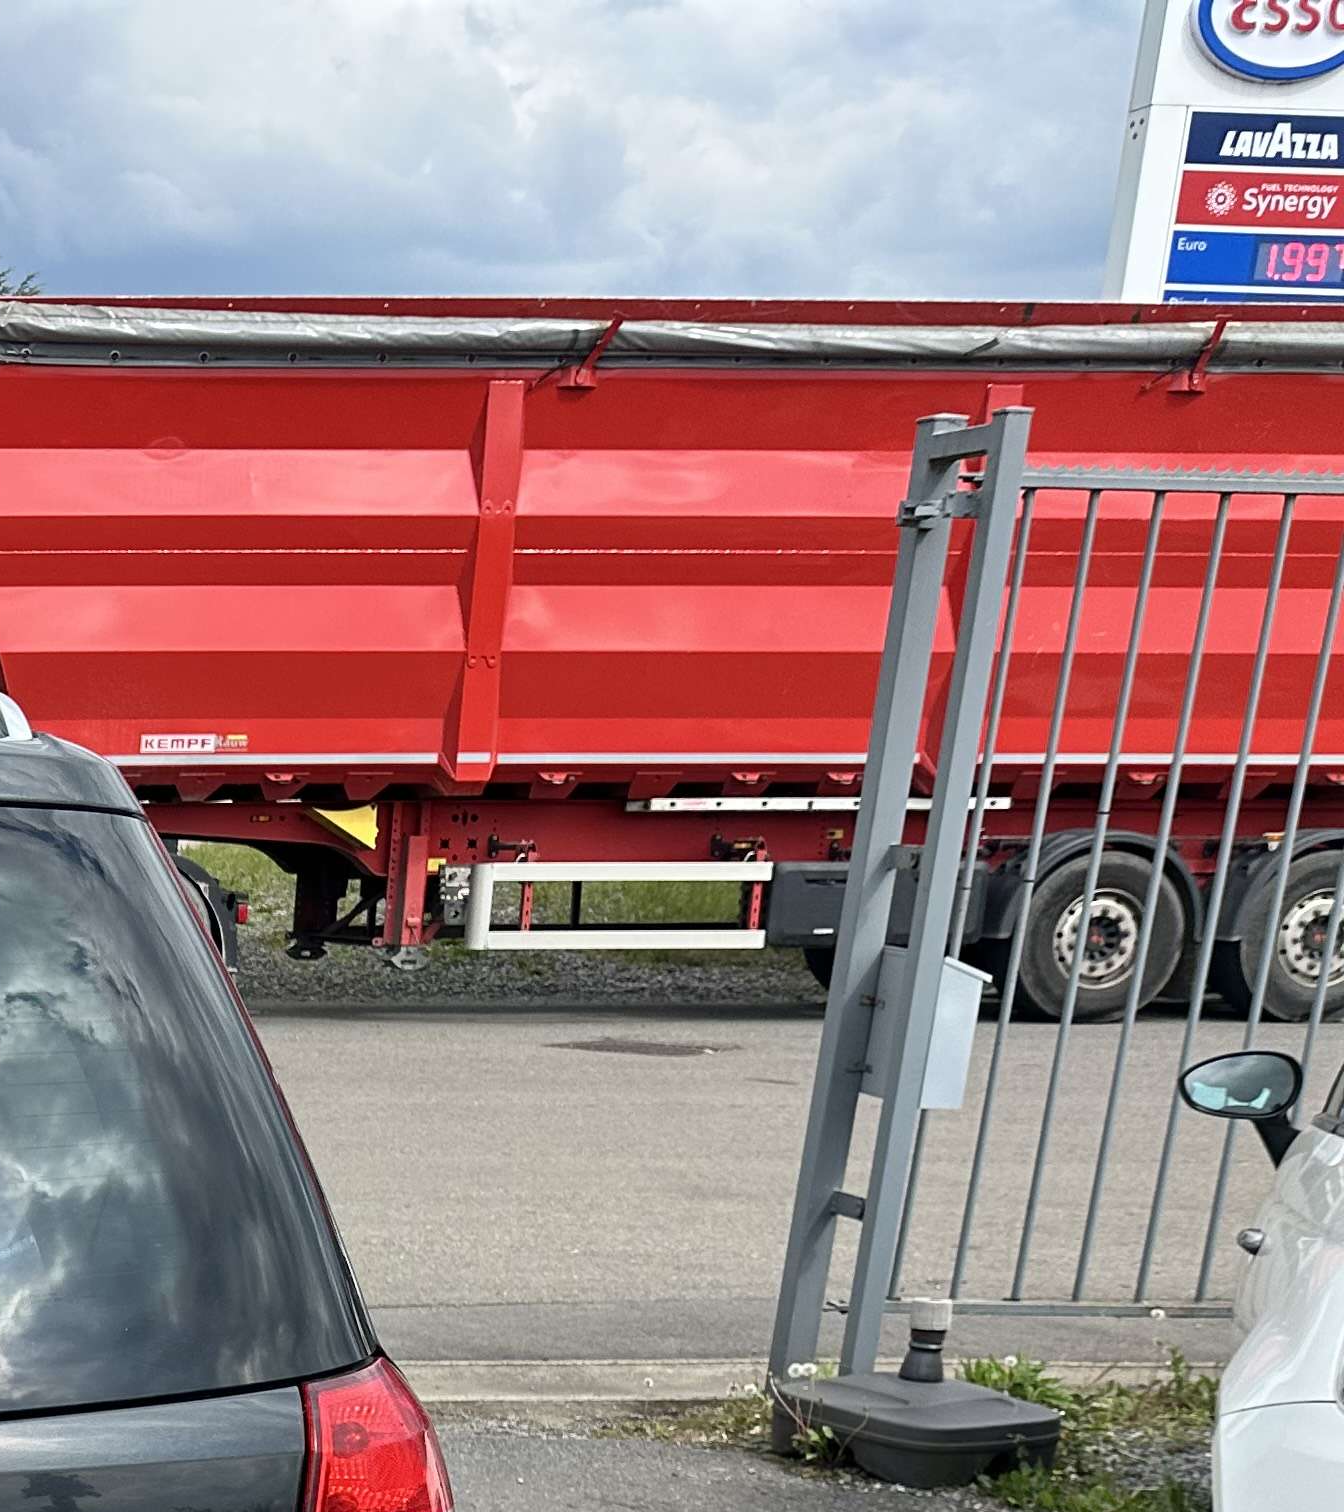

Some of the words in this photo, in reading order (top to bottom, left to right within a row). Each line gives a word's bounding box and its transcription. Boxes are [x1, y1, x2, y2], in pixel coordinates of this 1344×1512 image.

[1219, 122, 1339, 160] LAVAZZA
[1284, 183, 1340, 193] TECHNOLOGY
[1242, 187, 1338, 219] Synergy
[1176, 237, 1207, 251] Euro
[145, 738, 212, 749] KEMPF
